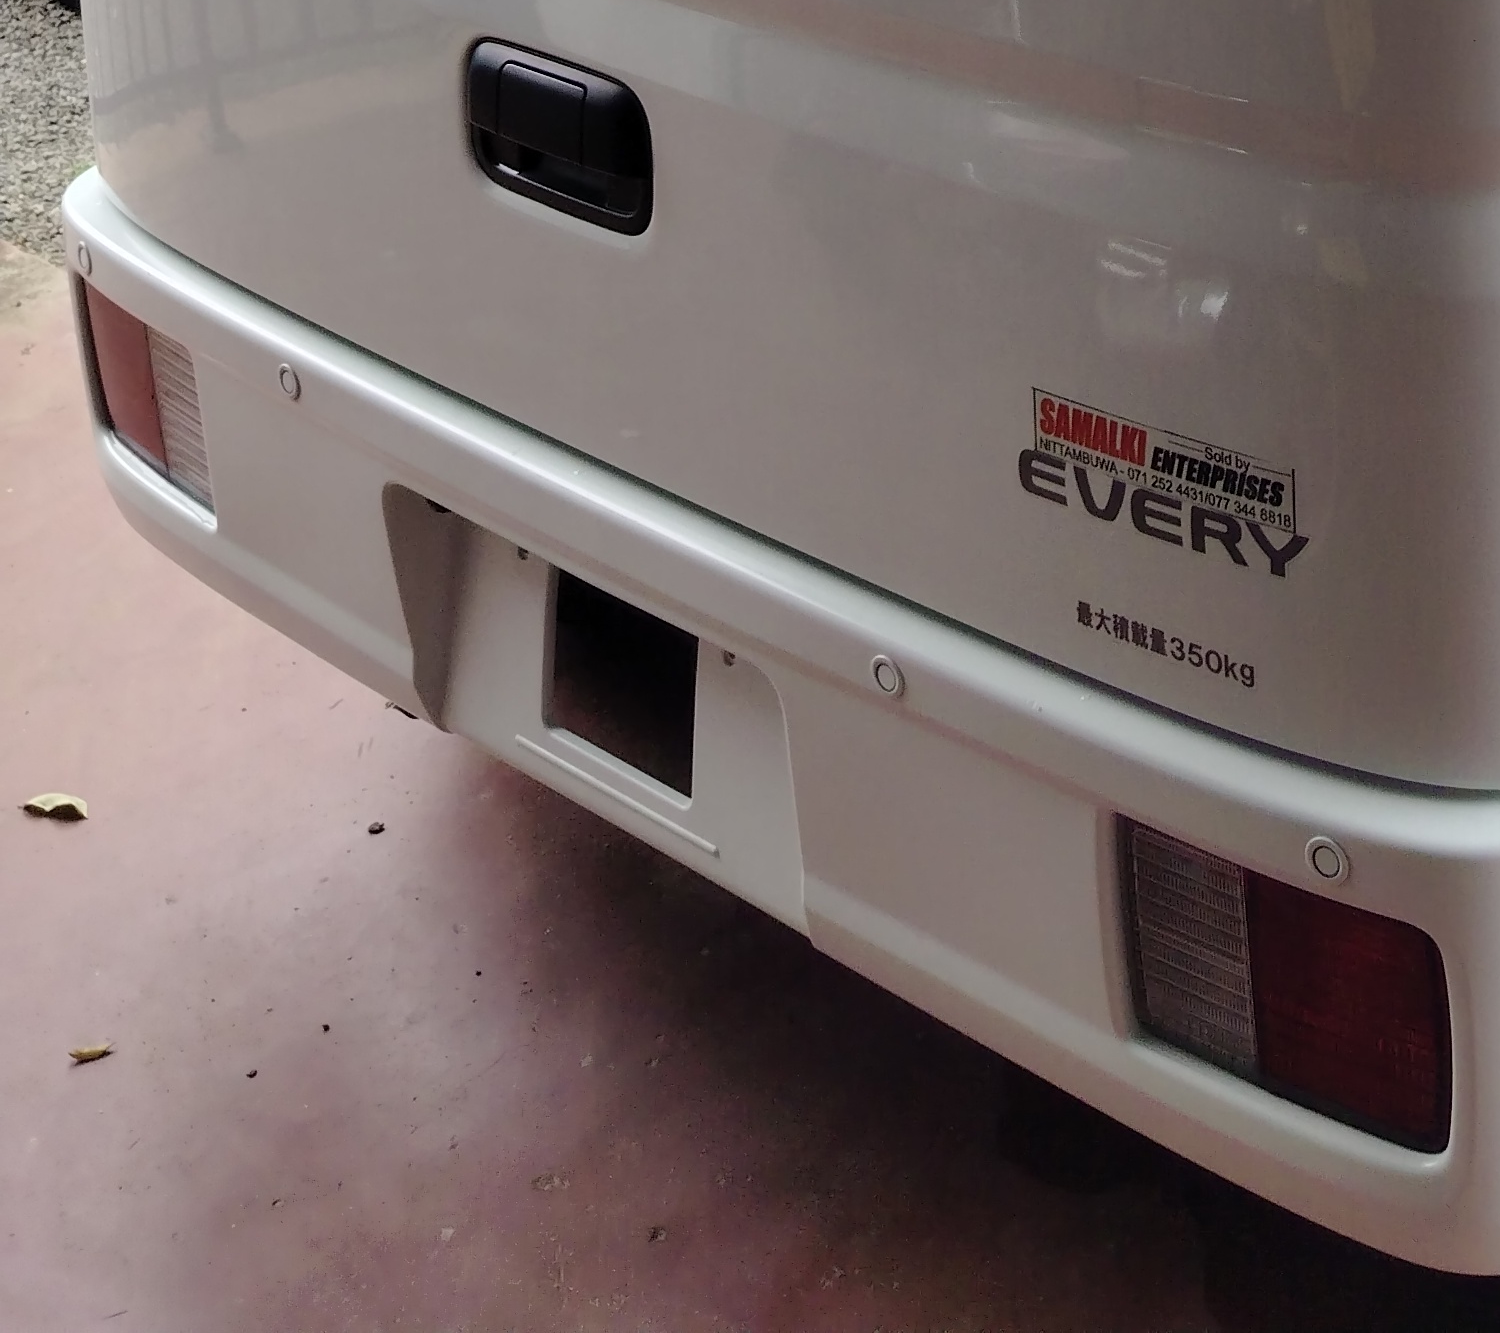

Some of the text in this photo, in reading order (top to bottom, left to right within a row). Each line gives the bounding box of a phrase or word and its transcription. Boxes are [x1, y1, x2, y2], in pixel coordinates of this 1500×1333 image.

[1040, 397, 1285, 507] SAMALKI ENTERPRISES
[1040, 437, 1119, 475] NITTAMBUWA
[1127, 466, 1147, 483] 071
[1151, 475, 1173, 494] 252
[1175, 484, 1231, 510] 4431/077
[1233, 500, 1256, 519] 344
[1260, 507, 1292, 529] 8818
[1204, 446, 1250, 474] Sold by
[1018, 448, 1309, 578] EVERY
